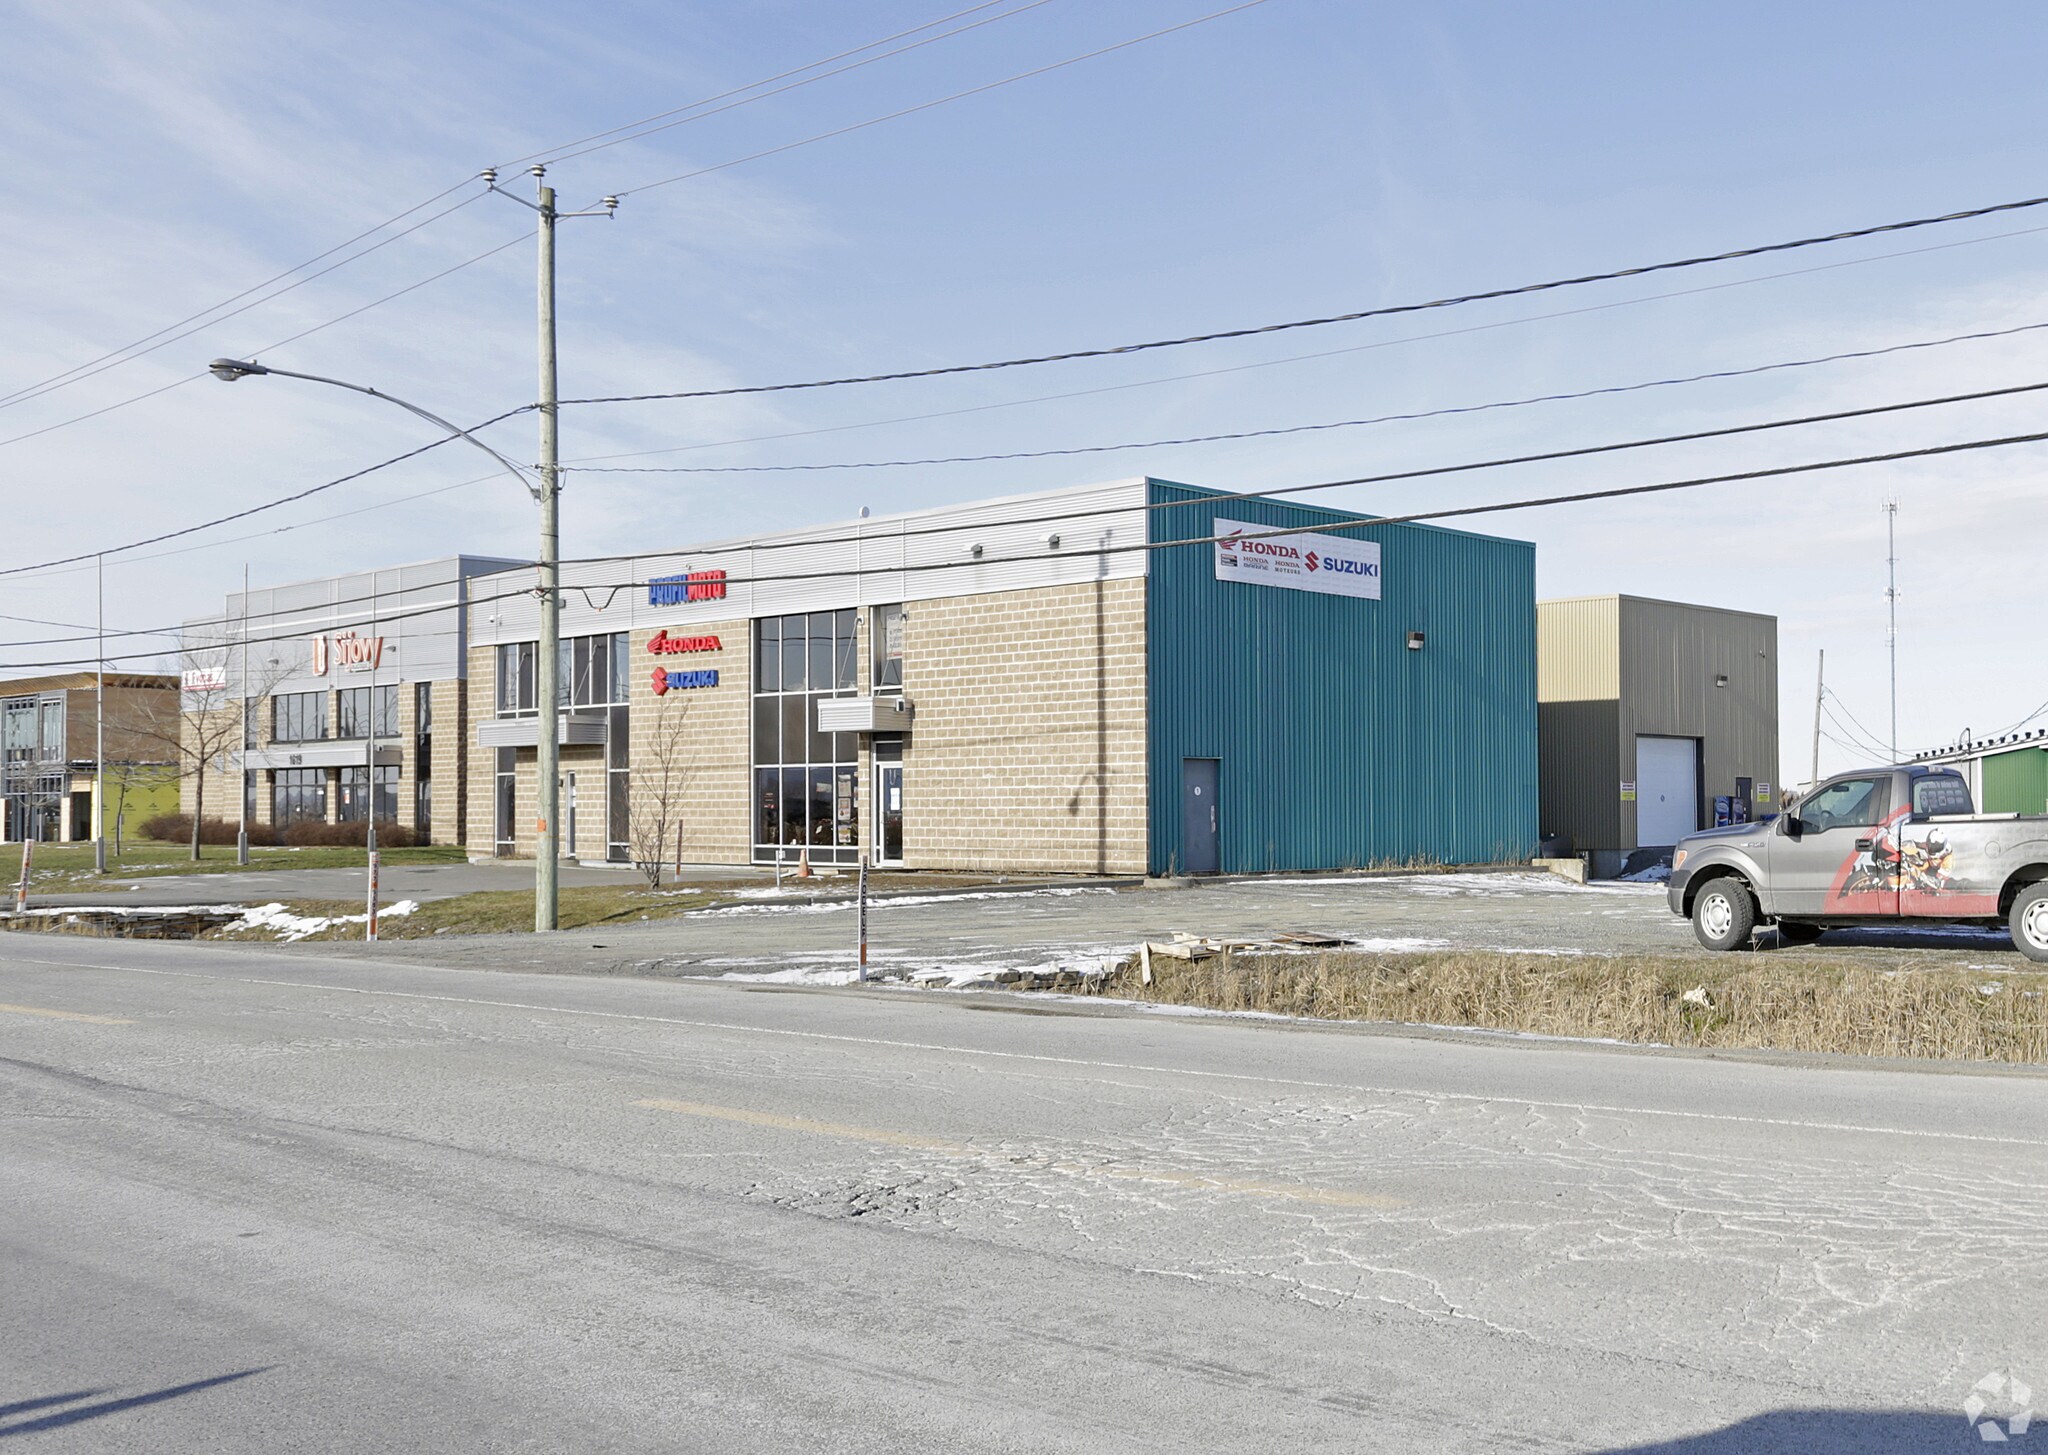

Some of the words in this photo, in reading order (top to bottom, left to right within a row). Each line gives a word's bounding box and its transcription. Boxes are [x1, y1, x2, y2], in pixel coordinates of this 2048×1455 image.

[1241, 541, 1300, 559] HONDA
[1243, 556, 1269, 564] HONDA
[1275, 560, 1300, 568] HONDA
[1323, 557, 1378, 577] SUZUKI
[660, 636, 720, 653] HONDA
[666, 670, 718, 688] SUZUKI
